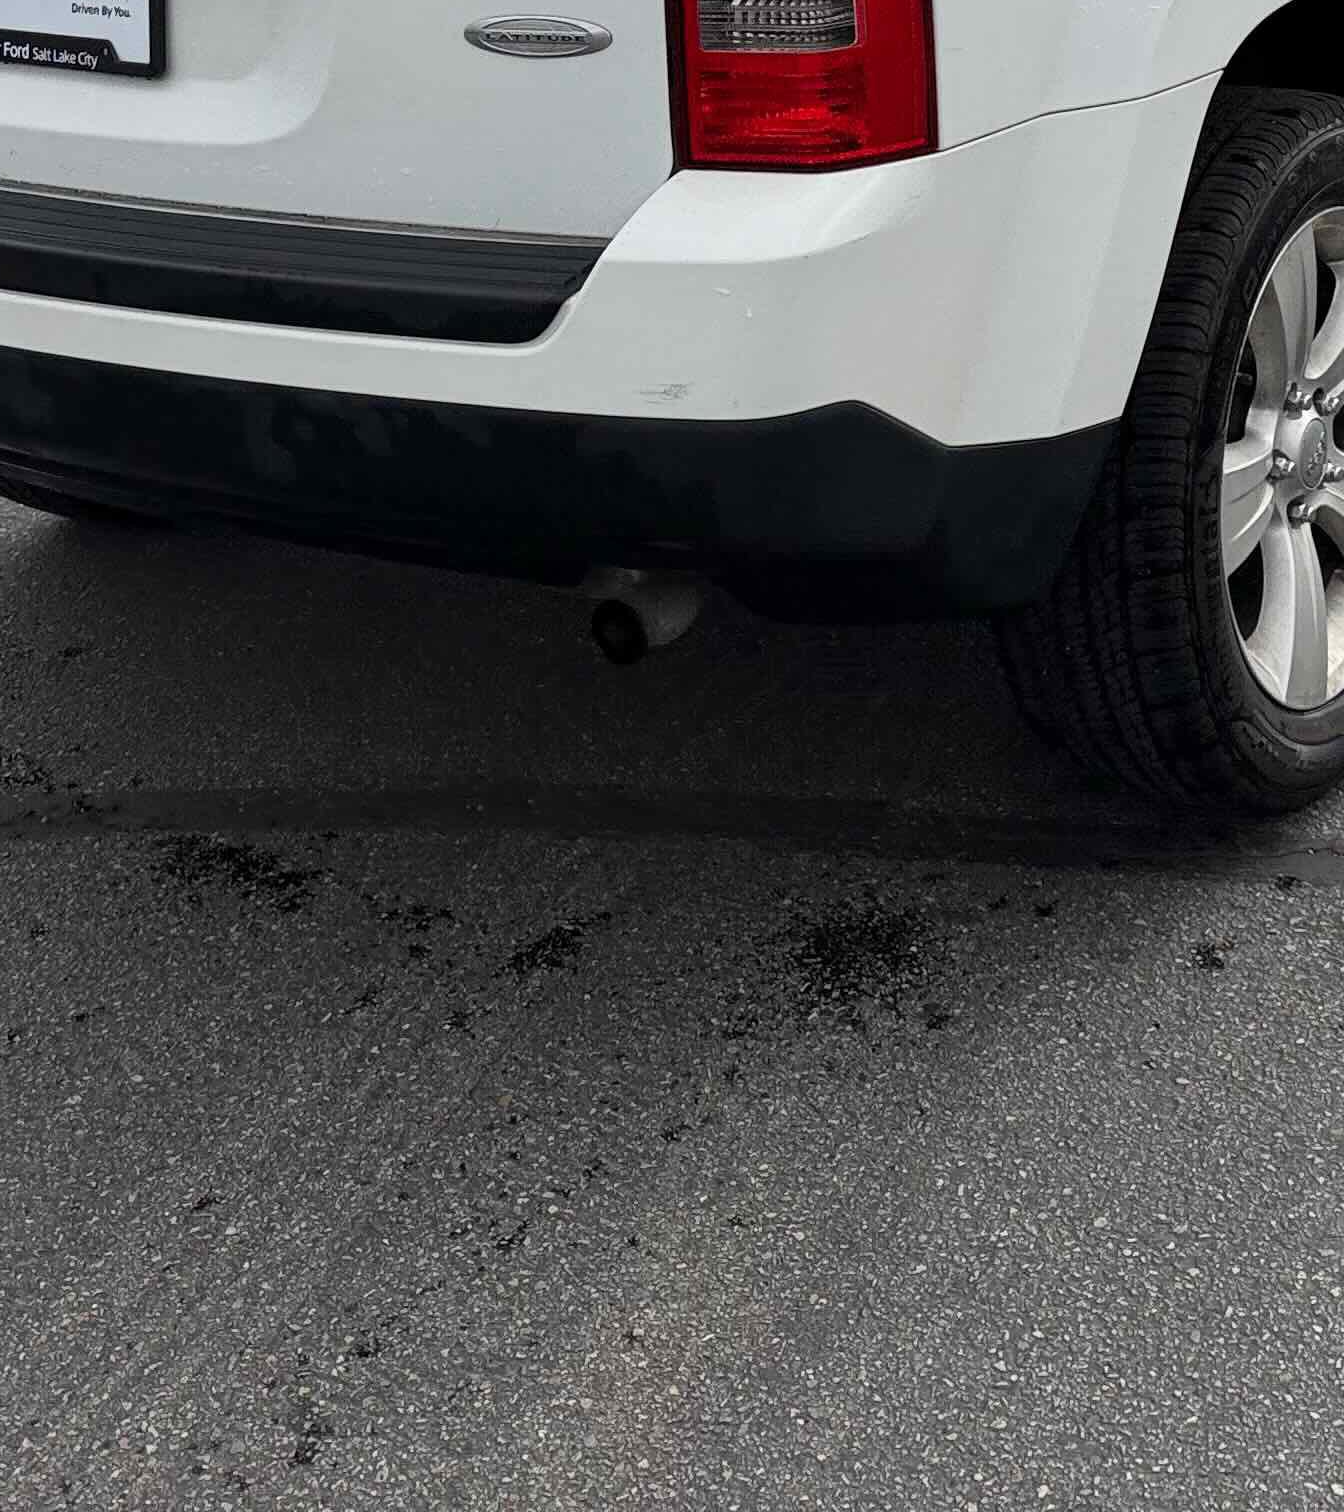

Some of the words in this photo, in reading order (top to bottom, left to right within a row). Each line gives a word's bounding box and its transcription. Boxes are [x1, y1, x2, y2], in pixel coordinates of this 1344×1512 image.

[71, 3, 100, 16] Driven
[101, 6, 113, 18] By
[485, 31, 585, 42] LATITUDE
[3, 42, 30, 59] Ford
[32, 47, 52, 60] Salt
[53, 49, 76, 64] Lake
[77, 52, 98, 69] City
